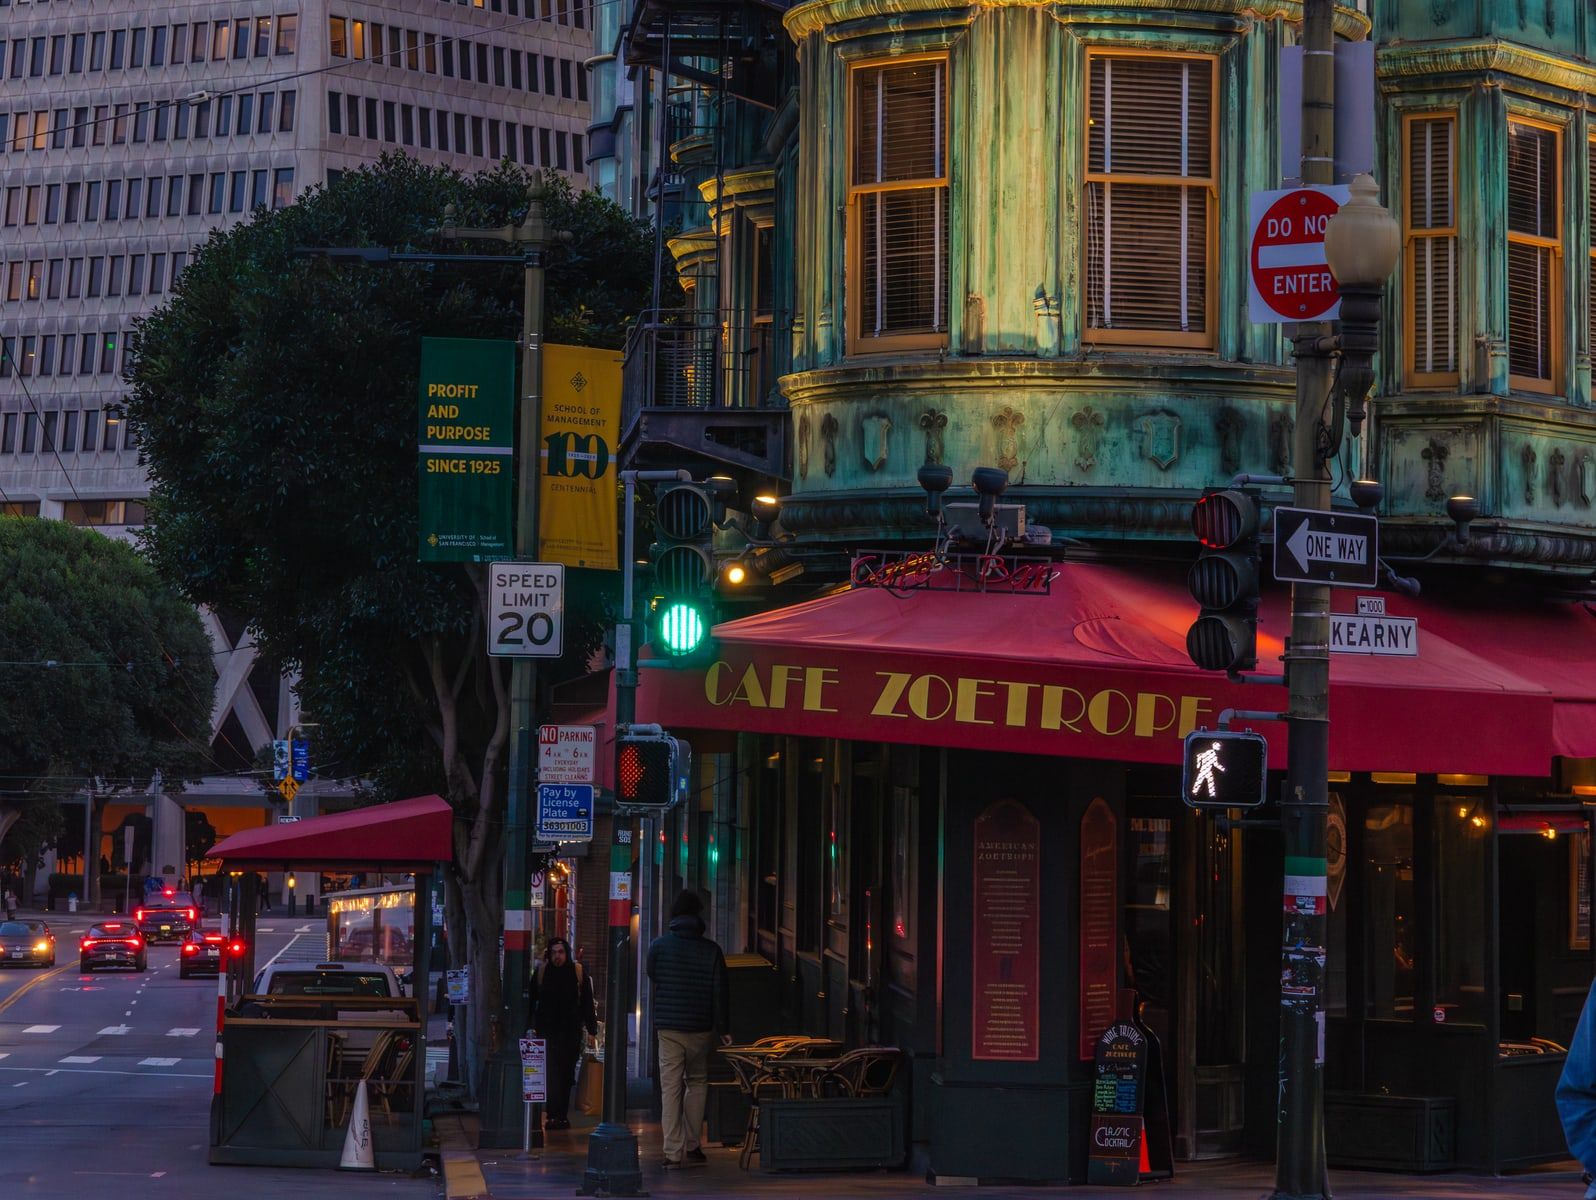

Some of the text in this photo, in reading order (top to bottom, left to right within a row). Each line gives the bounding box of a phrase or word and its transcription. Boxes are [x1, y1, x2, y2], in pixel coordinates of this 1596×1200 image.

[1267, 214, 1335, 238] DO NO
[1273, 273, 1332, 295] ENTER
[428, 384, 478, 398] PROFIT
[427, 405, 459, 419] AND
[554, 404, 601, 415] SCHOOL OF
[547, 415, 607, 427] MANAGEMENT
[427, 426, 490, 441] PURPOSE
[543, 431, 609, 480] 100
[427, 459, 500, 474] SINCE 1925
[551, 483, 597, 495] CENTENNIAL
[1306, 534, 1364, 561] ONE WAY
[496, 574, 557, 589] SPEED
[502, 593, 550, 607] LIMIT
[1366, 600, 1383, 613] 1000
[497, 611, 554, 646] 20
[1332, 621, 1413, 649] KEARNY
[704, 660, 1213, 739] CAFE ZOETROPE
[540, 727, 593, 743] NO PARKING
[545, 747, 551, 757] 4
[573, 747, 579, 758] 6
[543, 787, 577, 798] Pay by
[543, 798, 579, 808] License
[543, 808, 568, 817] Plate
[978, 842, 1035, 850] AMERICAN
[1095, 1126, 1130, 1143] CLASSIC
[1095, 1136, 1136, 1148] COCKTAILS
